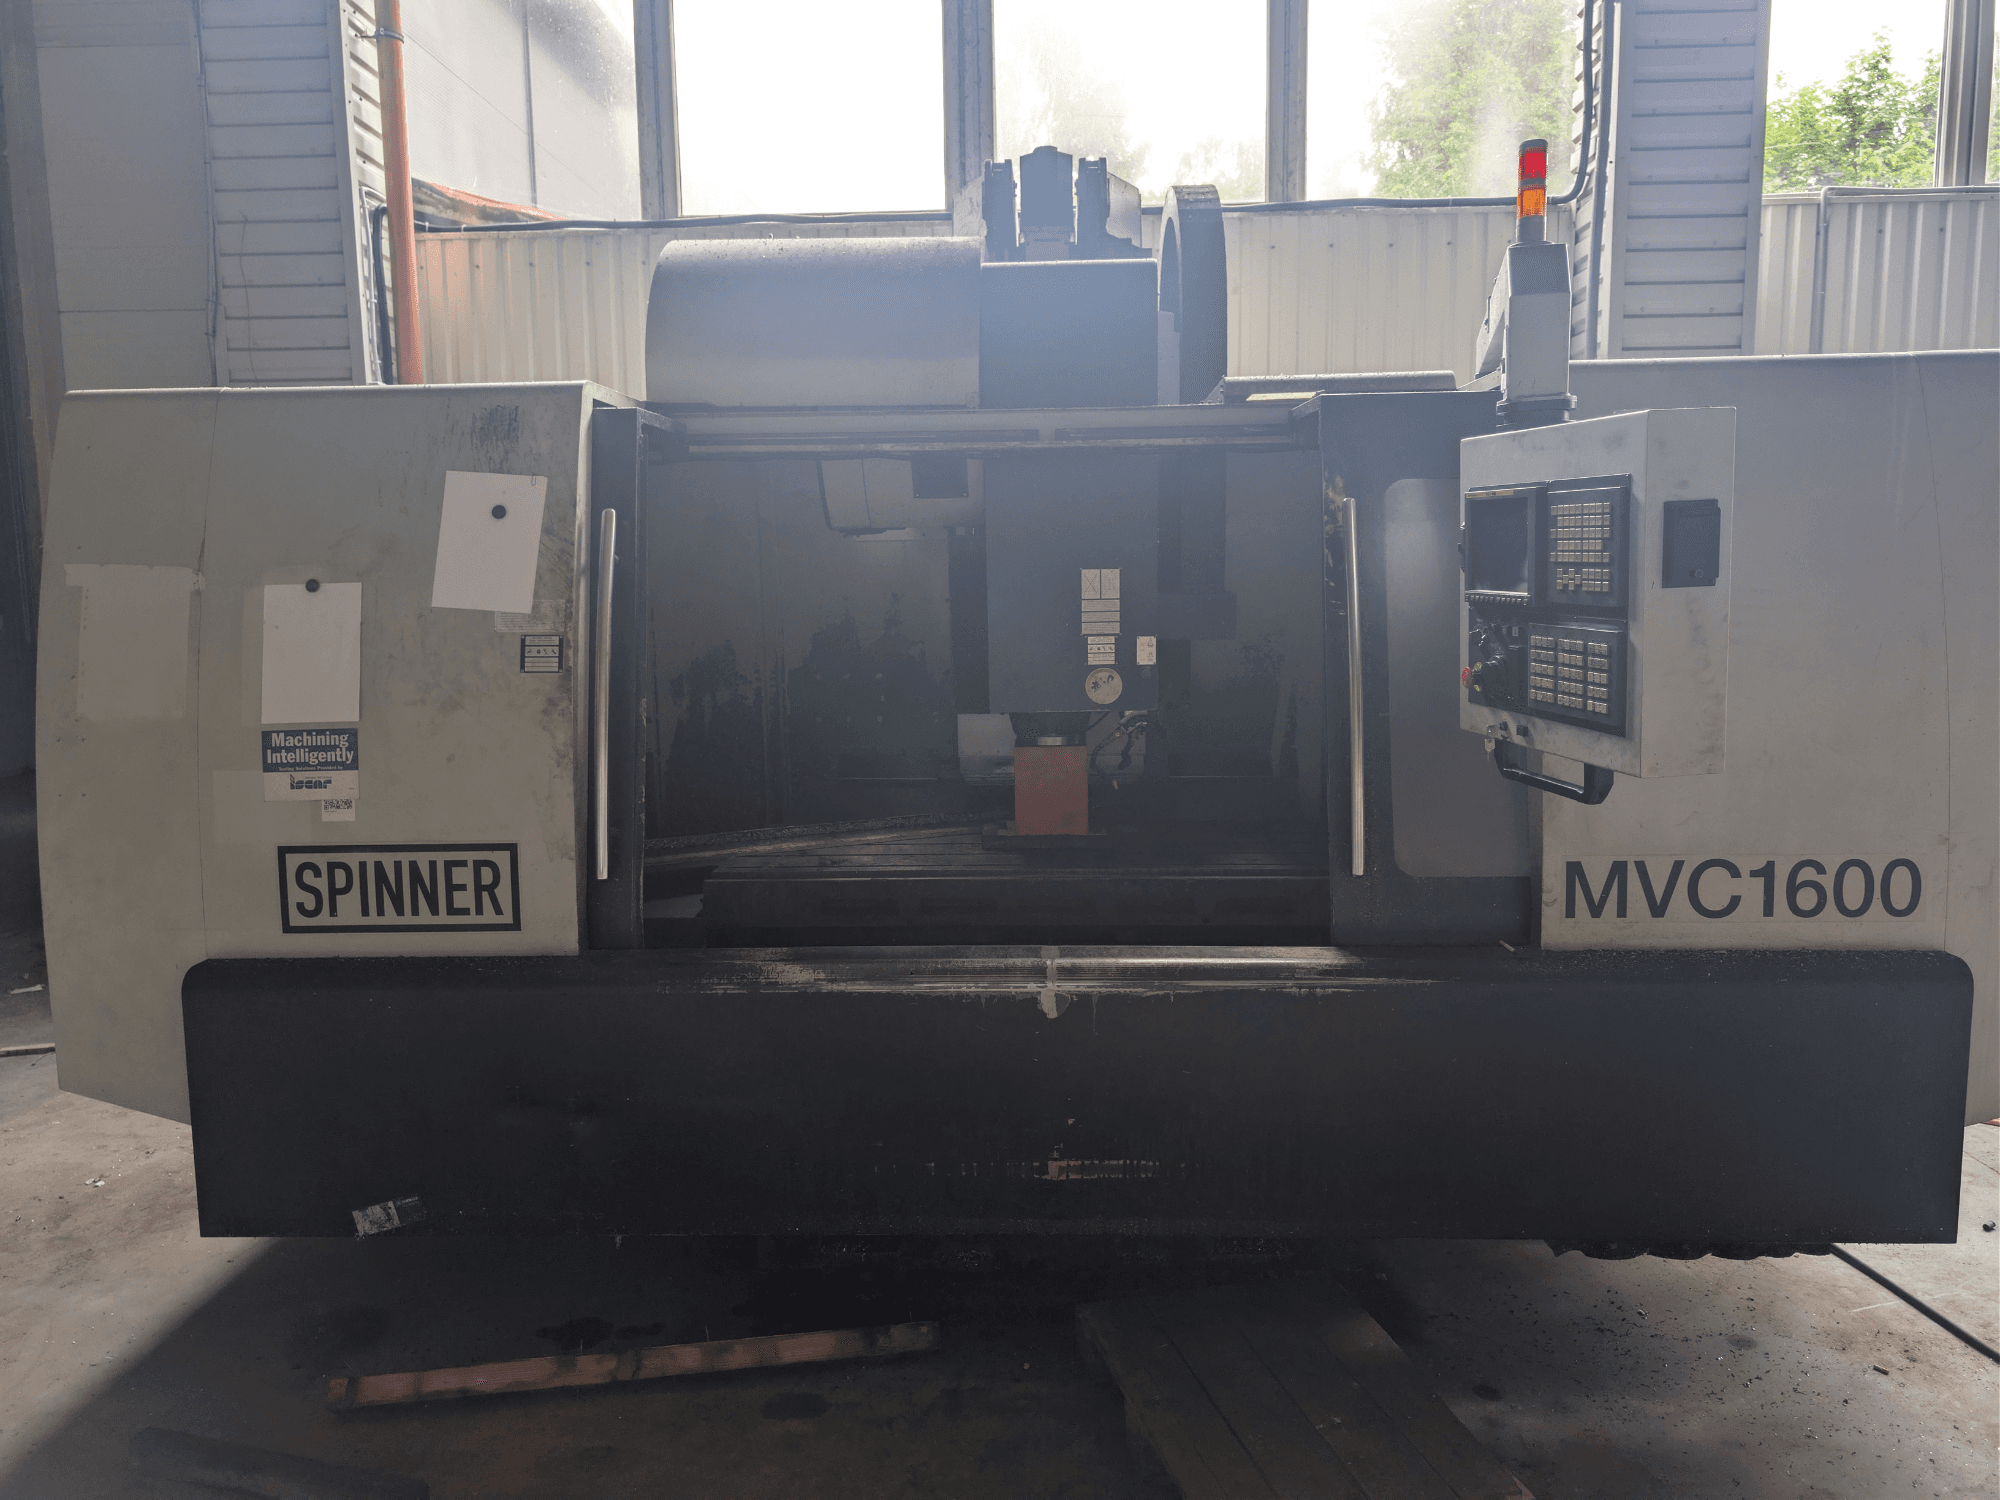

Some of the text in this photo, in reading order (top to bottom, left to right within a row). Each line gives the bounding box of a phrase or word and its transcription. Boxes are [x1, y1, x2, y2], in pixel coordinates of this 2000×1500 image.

[266, 747, 354, 765] Intelligently
[271, 731, 349, 748] Machining
[294, 859, 504, 919] SPINNER
[1564, 858, 1923, 919] MVC1600
